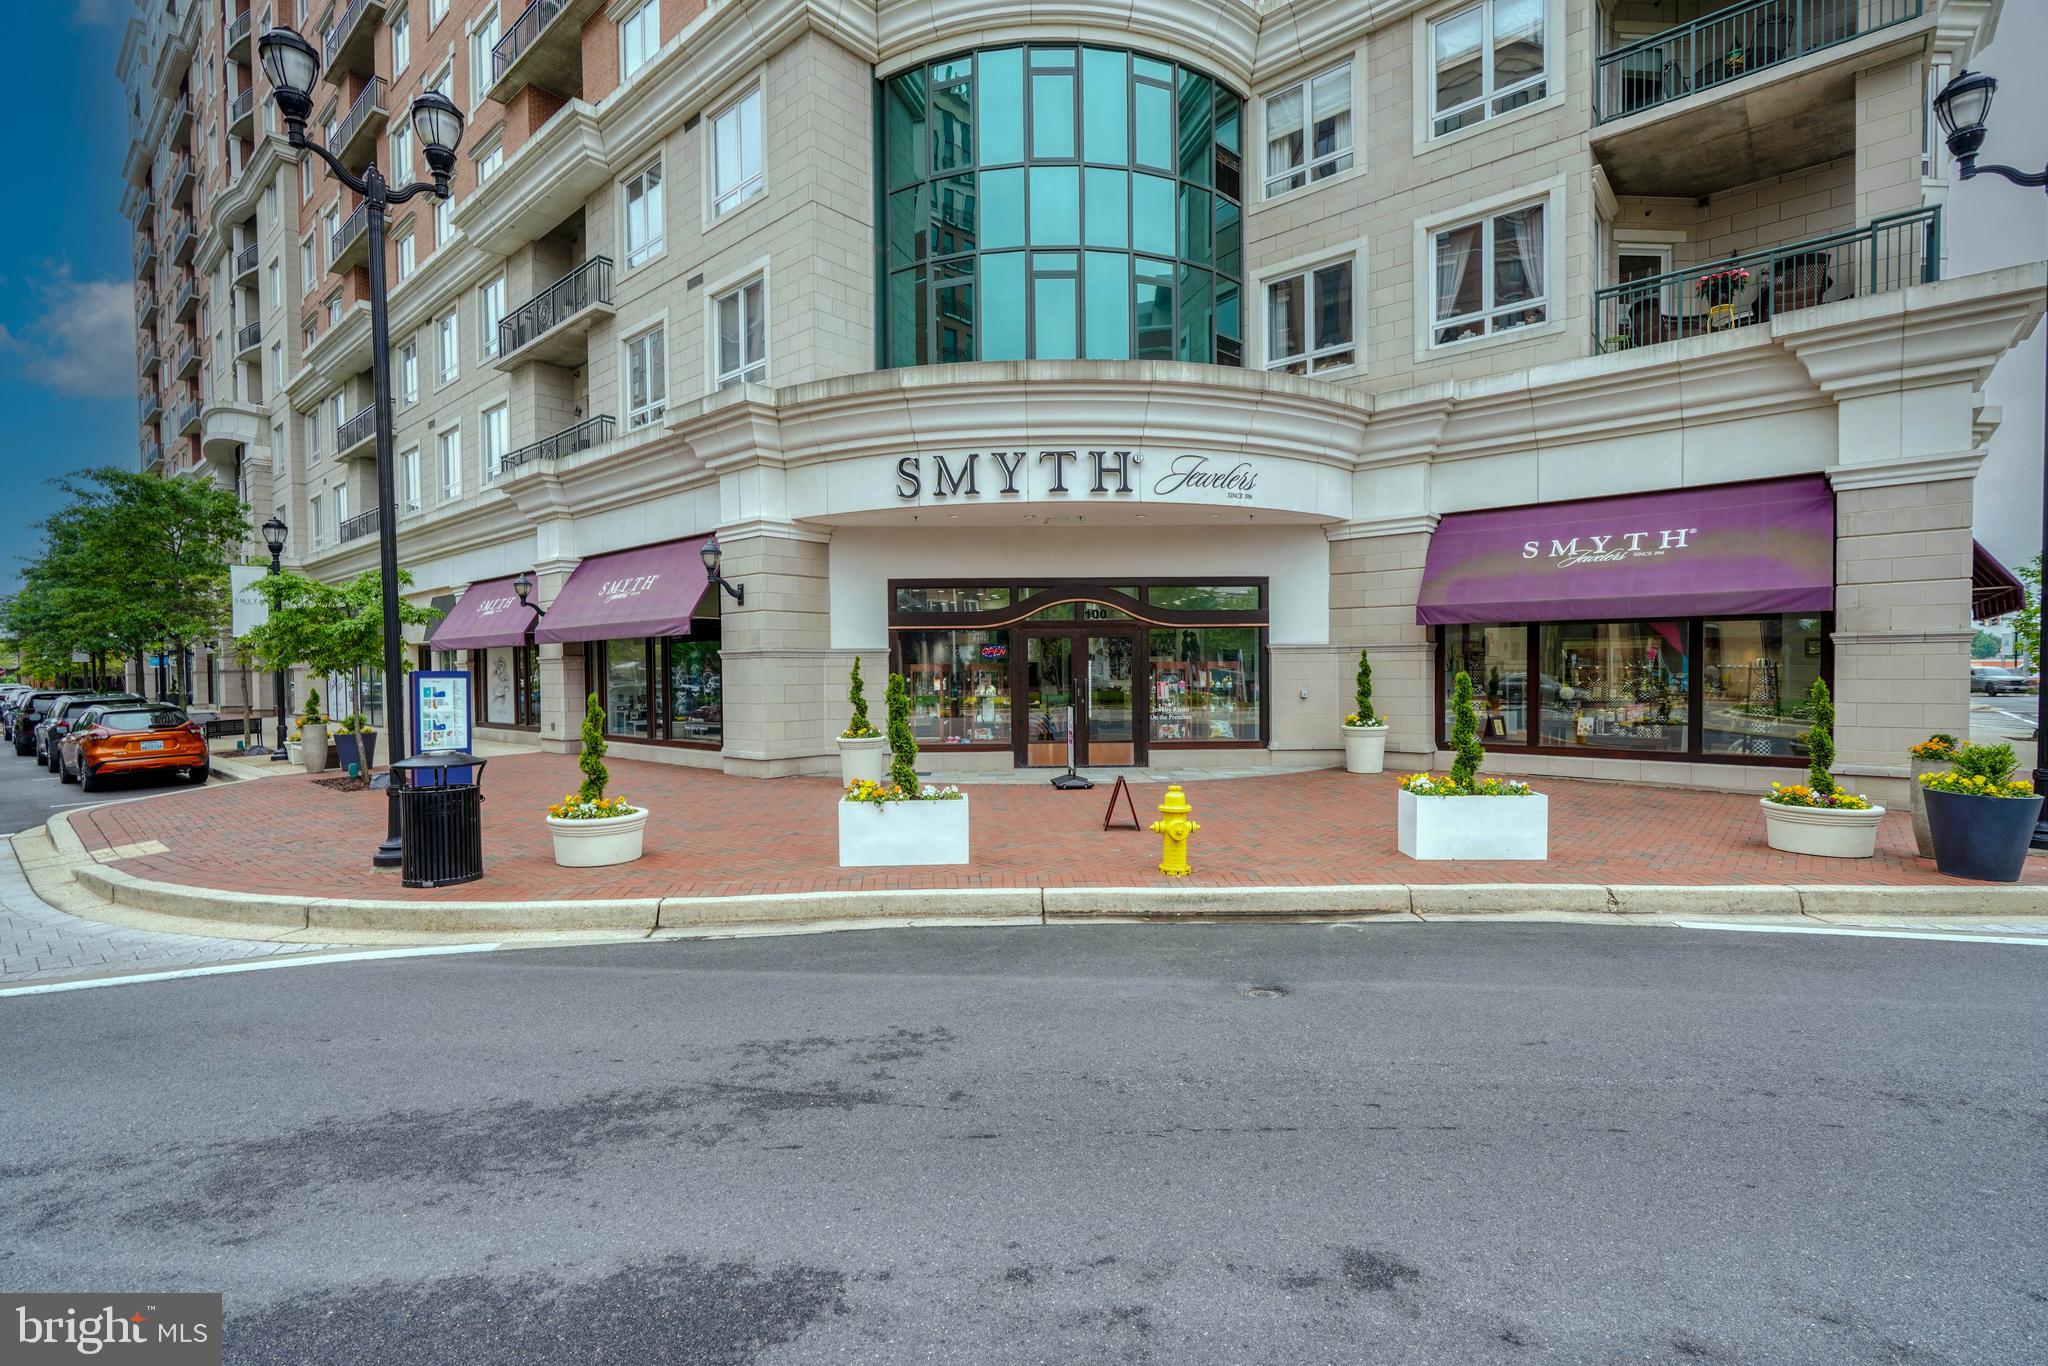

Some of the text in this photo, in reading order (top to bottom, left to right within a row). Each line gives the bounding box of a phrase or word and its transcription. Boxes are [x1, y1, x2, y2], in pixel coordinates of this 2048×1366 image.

[1154, 455, 1258, 495] Jewelers
[1557, 548, 1627, 568] Jewelers
[1085, 609, 1107, 620] 100
[982, 646, 1007, 656] OPEN
